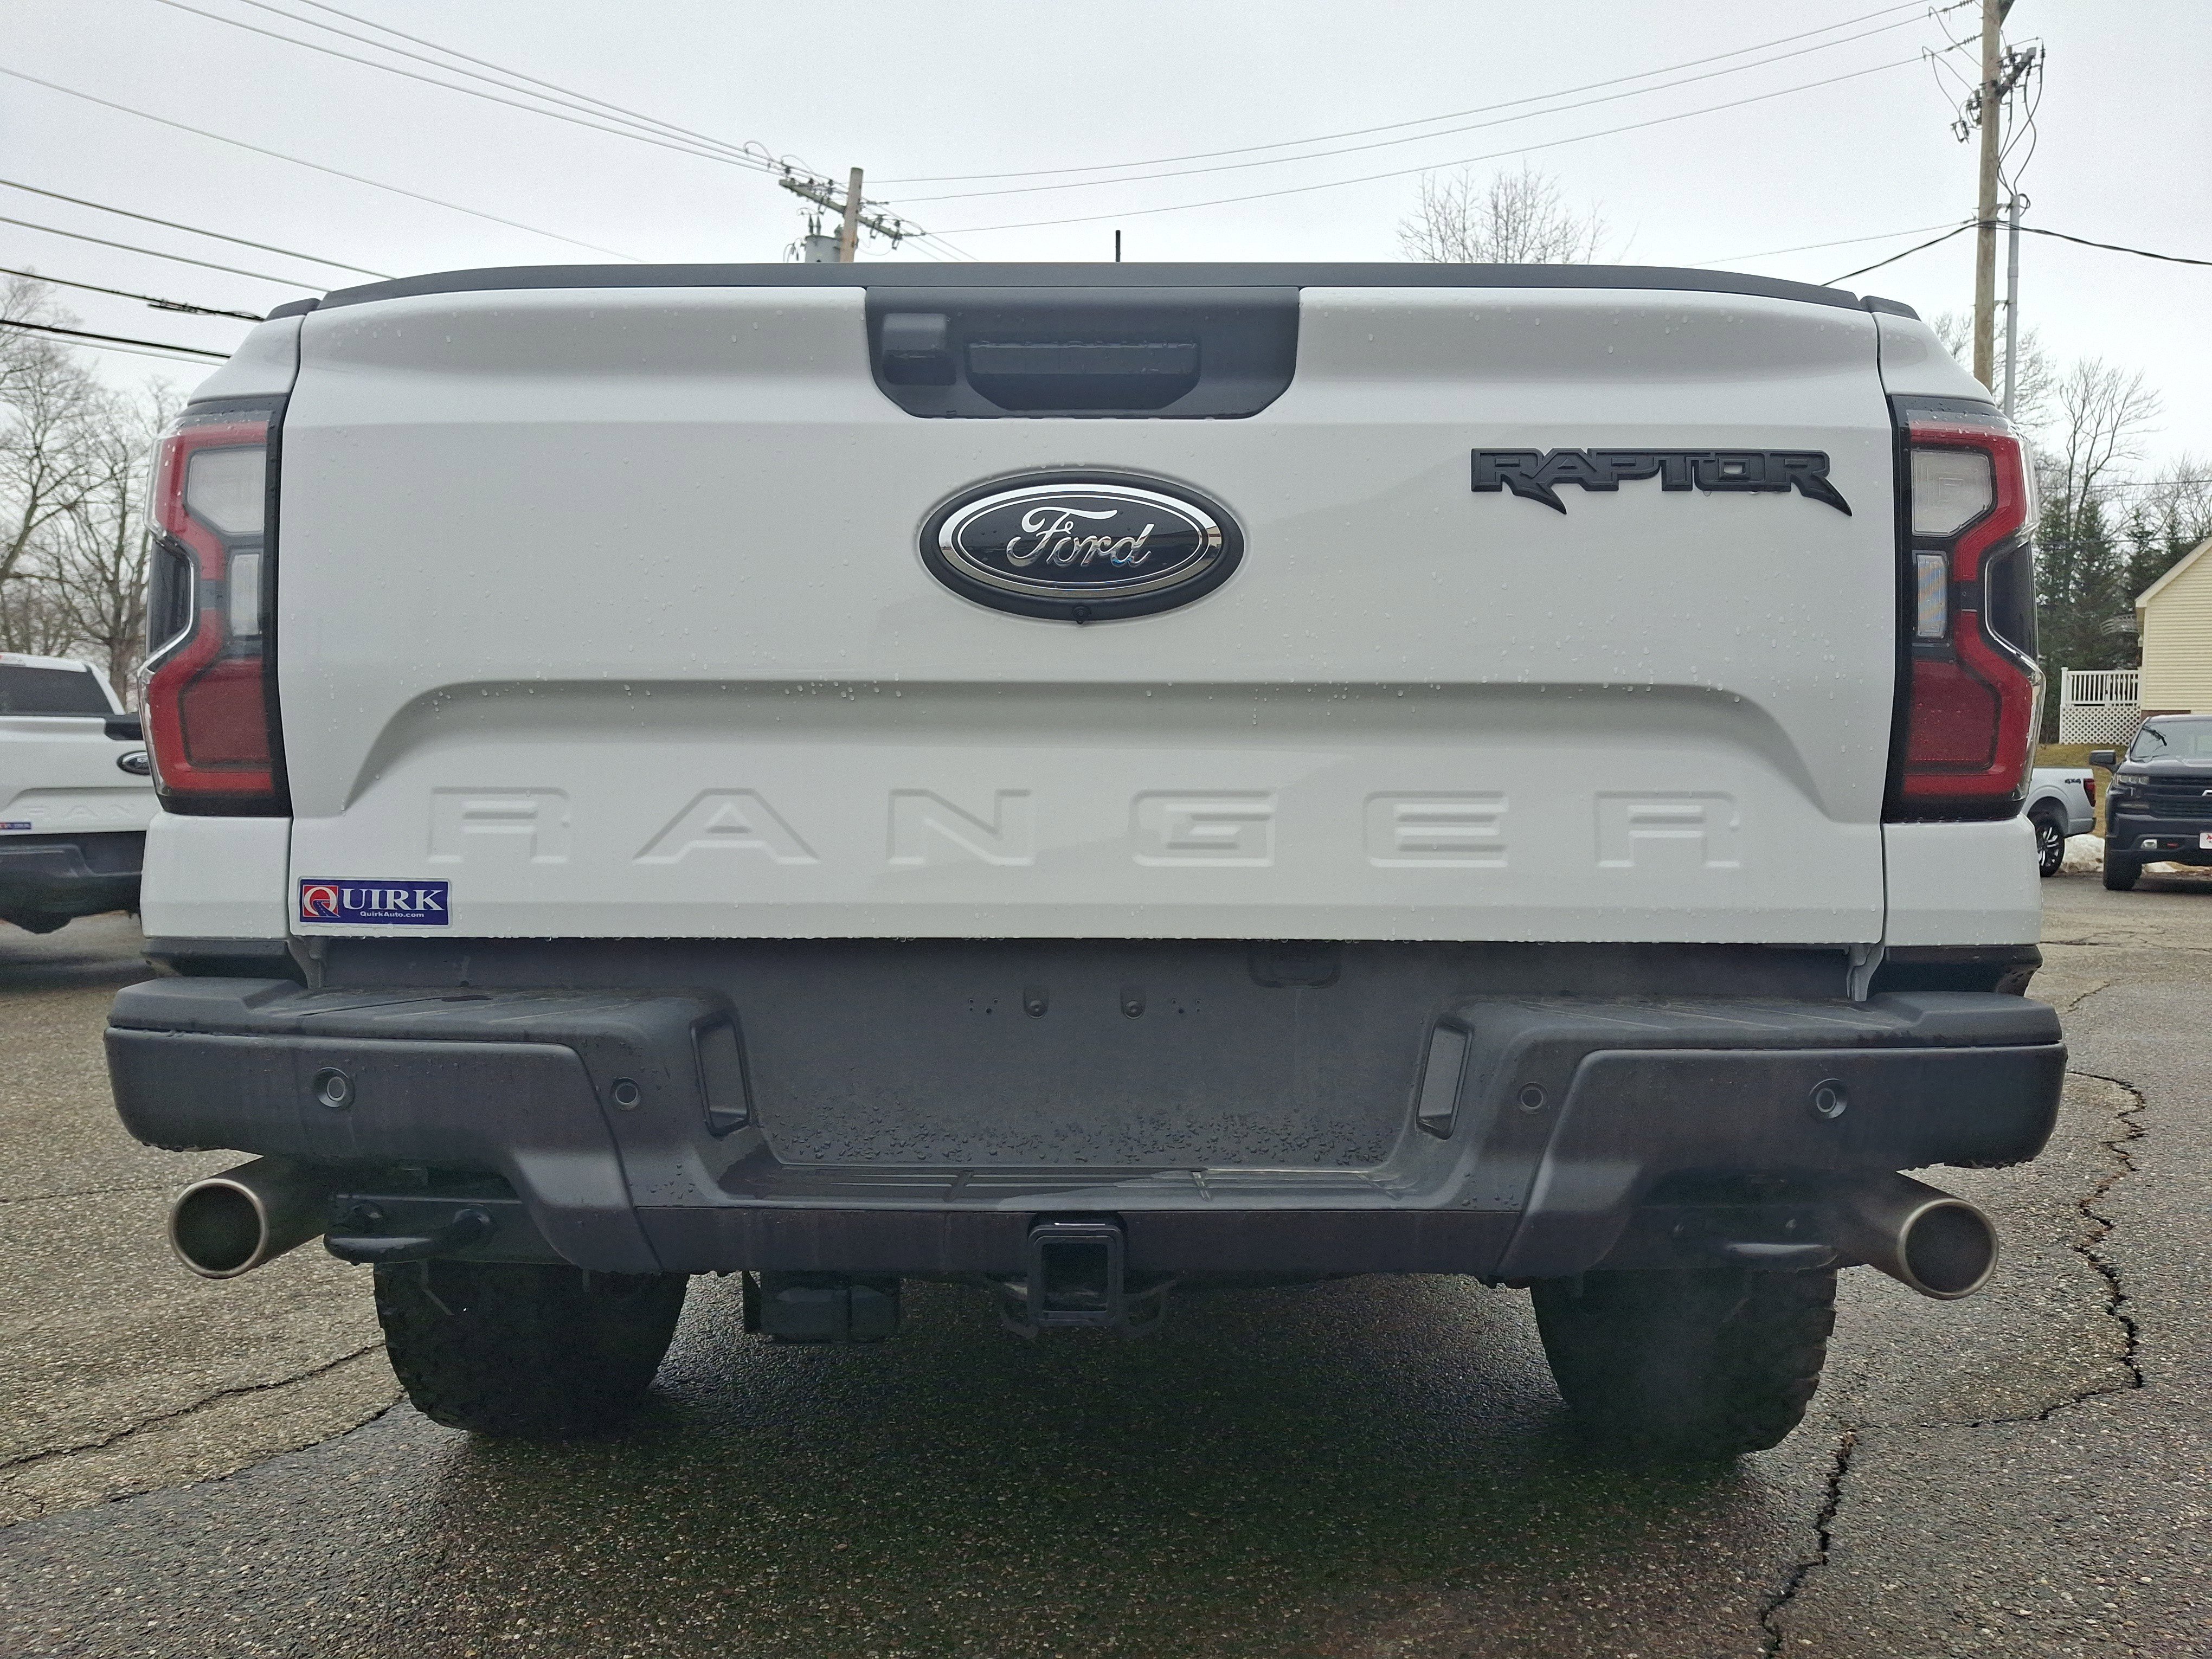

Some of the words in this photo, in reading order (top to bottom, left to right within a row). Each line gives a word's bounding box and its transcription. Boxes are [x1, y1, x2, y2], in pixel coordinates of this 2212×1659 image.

[1471, 448, 1853, 516] RAPTOR
[1006, 506, 1155, 567] Ford
[427, 786, 1741, 869] RANGER
[303, 886, 445, 917] QUIRK
